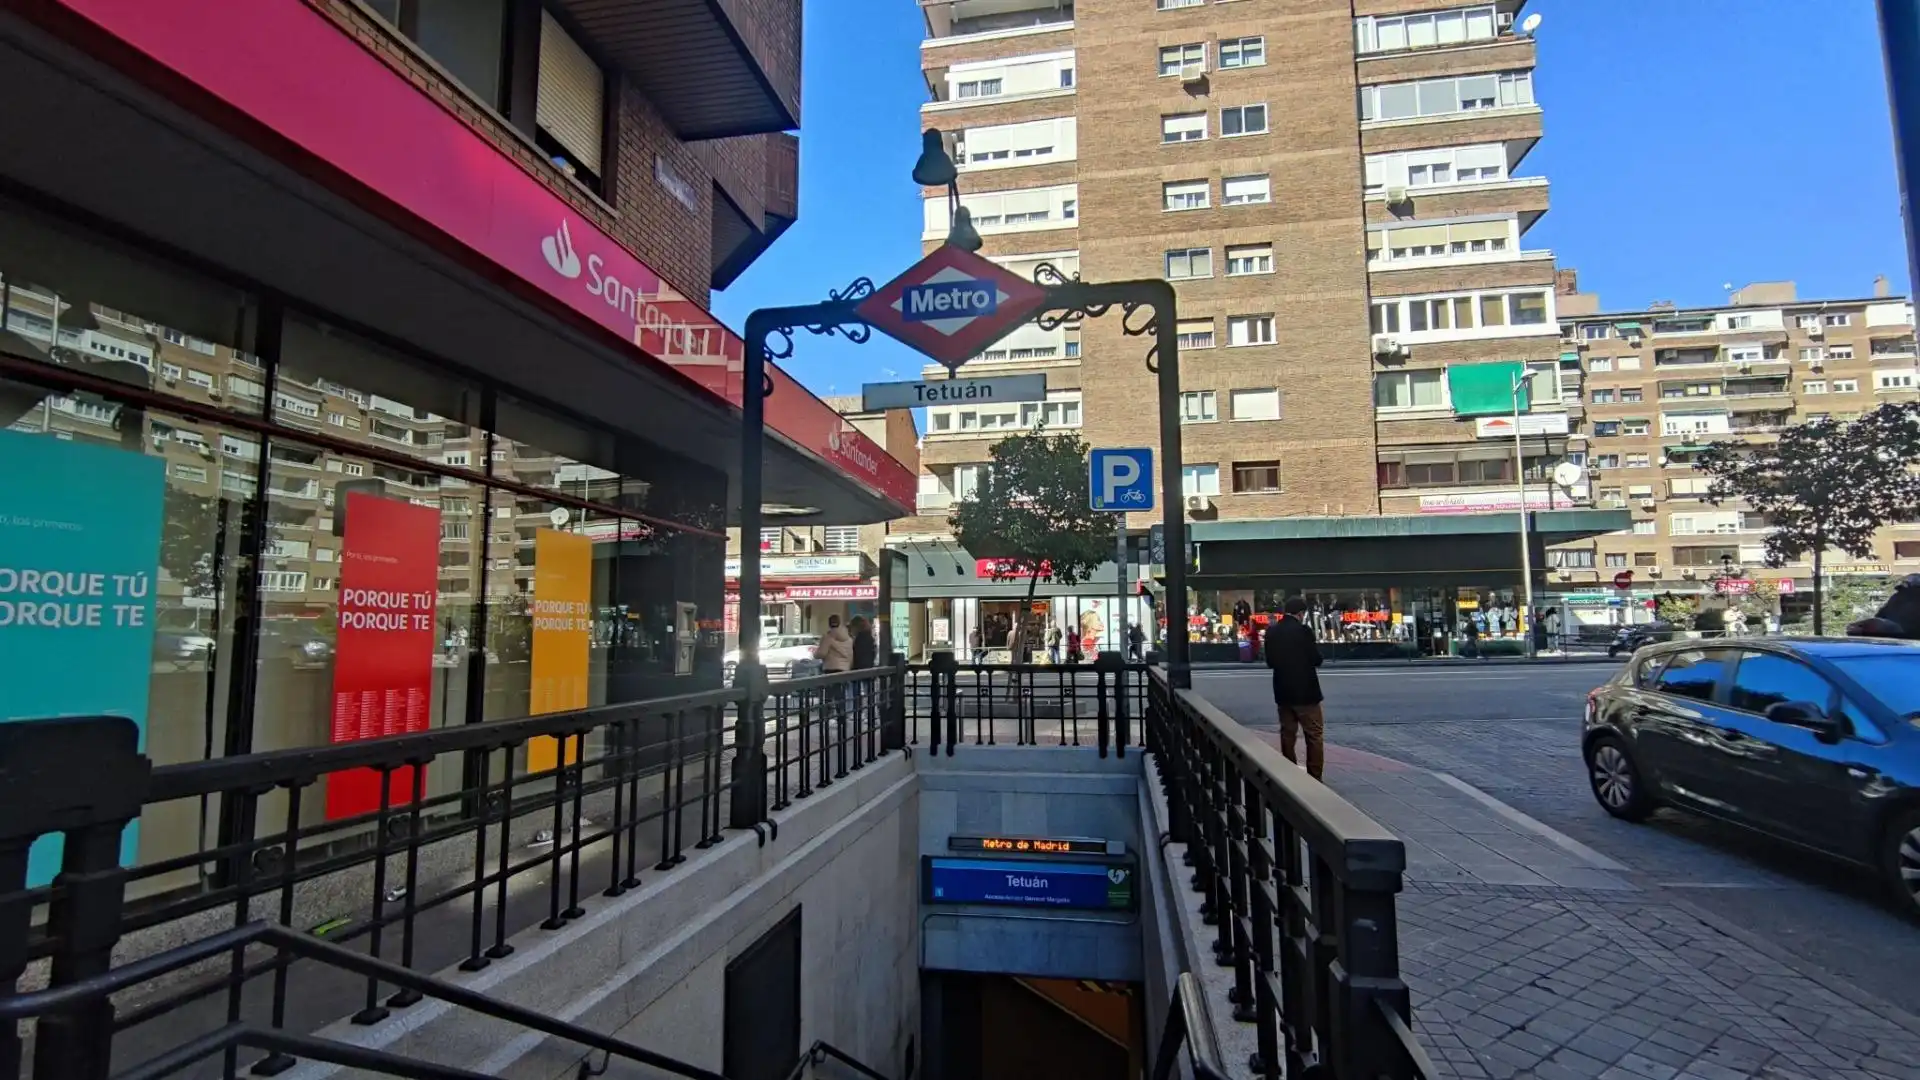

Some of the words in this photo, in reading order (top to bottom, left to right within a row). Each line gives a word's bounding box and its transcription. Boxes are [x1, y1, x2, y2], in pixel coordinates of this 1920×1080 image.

[586, 254, 704, 352] Santander
[910, 287, 990, 314] Metro
[914, 382, 993, 401] Tetuán
[1102, 455, 1140, 503] P
[112, 571, 148, 598] TÚ
[343, 588, 410, 609] PORQUE
[412, 591, 432, 609] TÚ
[535, 599, 575, 614] PORQUE
[112, 604, 146, 627] TE
[341, 611, 409, 631] PORQUE
[412, 614, 430, 630] TE
[535, 616, 574, 631] PORQUE
[983, 839, 1012, 849] Metro
[1016, 840, 1030, 849] de
[1034, 841, 1070, 851] Madrid
[1006, 874, 1049, 889] Tetuán
